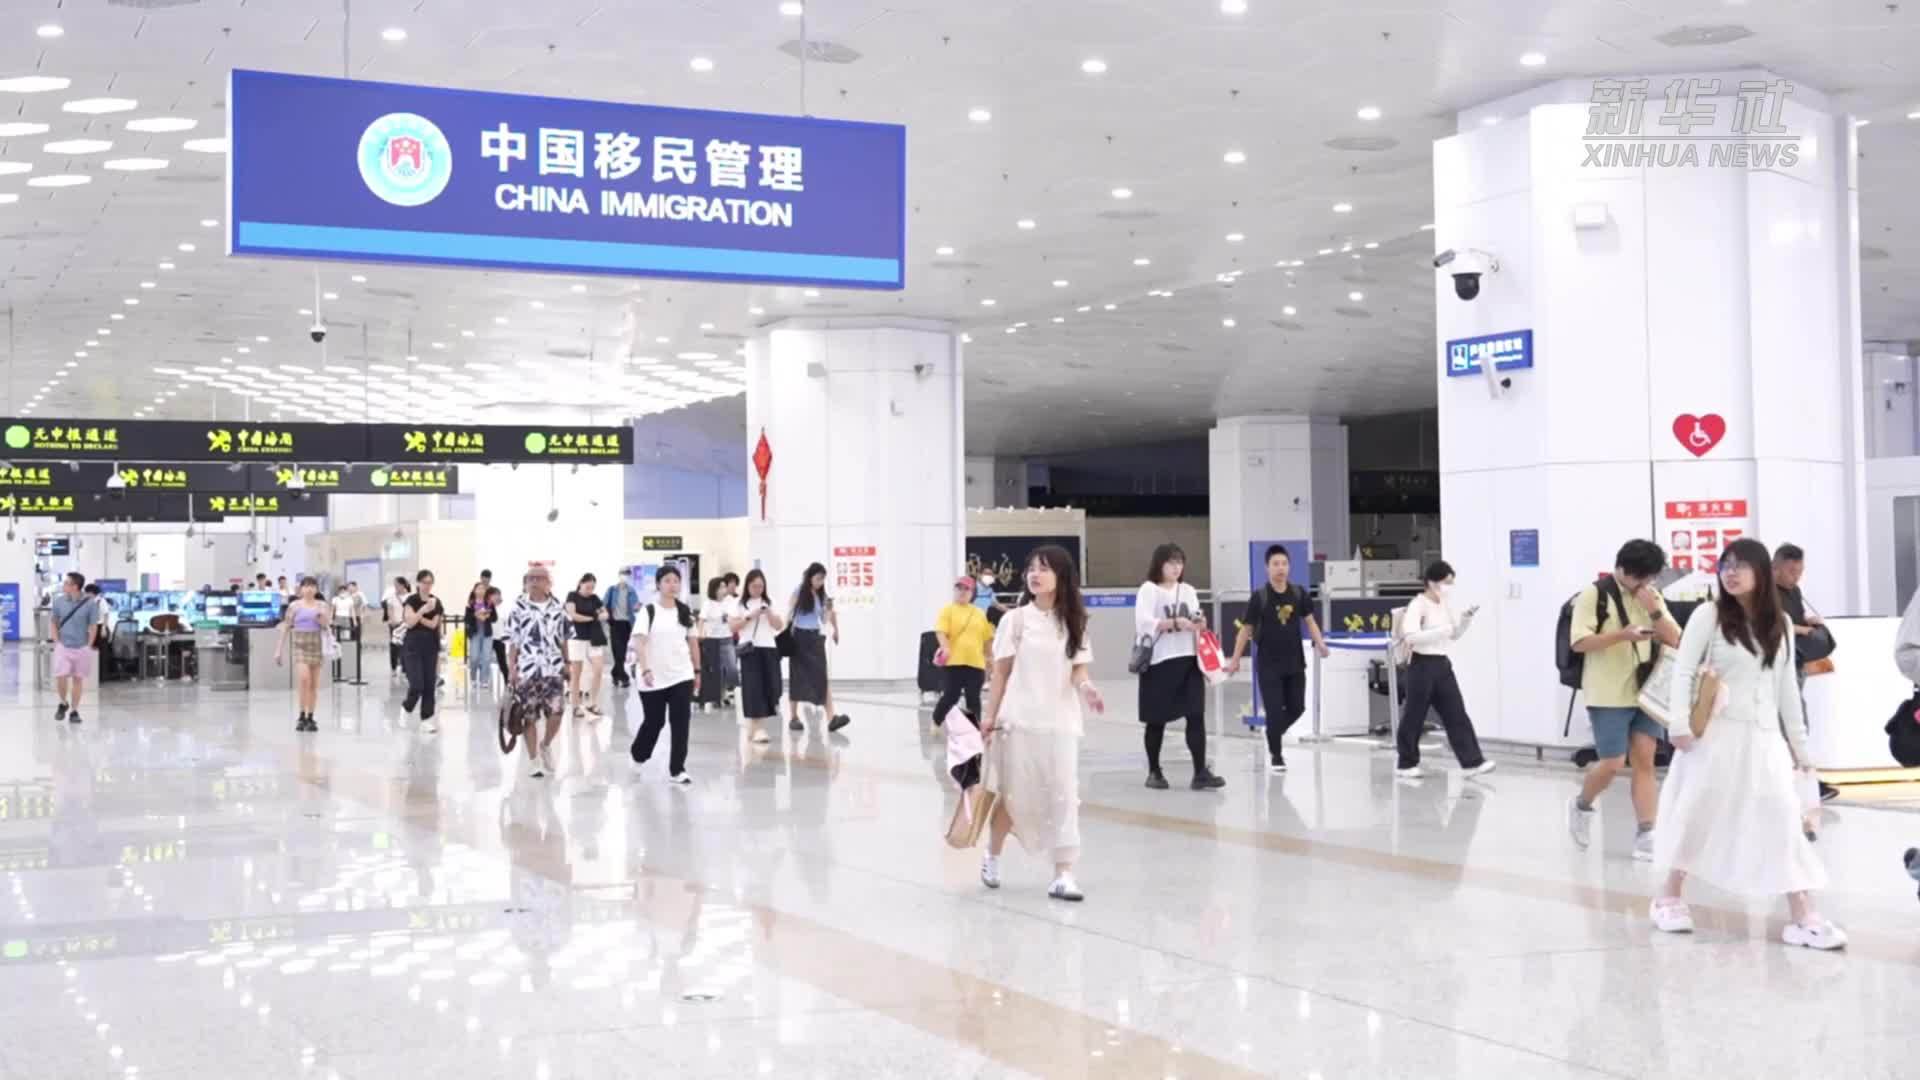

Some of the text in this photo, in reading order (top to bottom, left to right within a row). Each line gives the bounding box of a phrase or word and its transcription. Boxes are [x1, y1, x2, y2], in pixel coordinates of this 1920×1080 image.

[480, 122, 804, 192] 中国移民管理
[494, 183, 793, 228] CHINA IMMIGRATION
